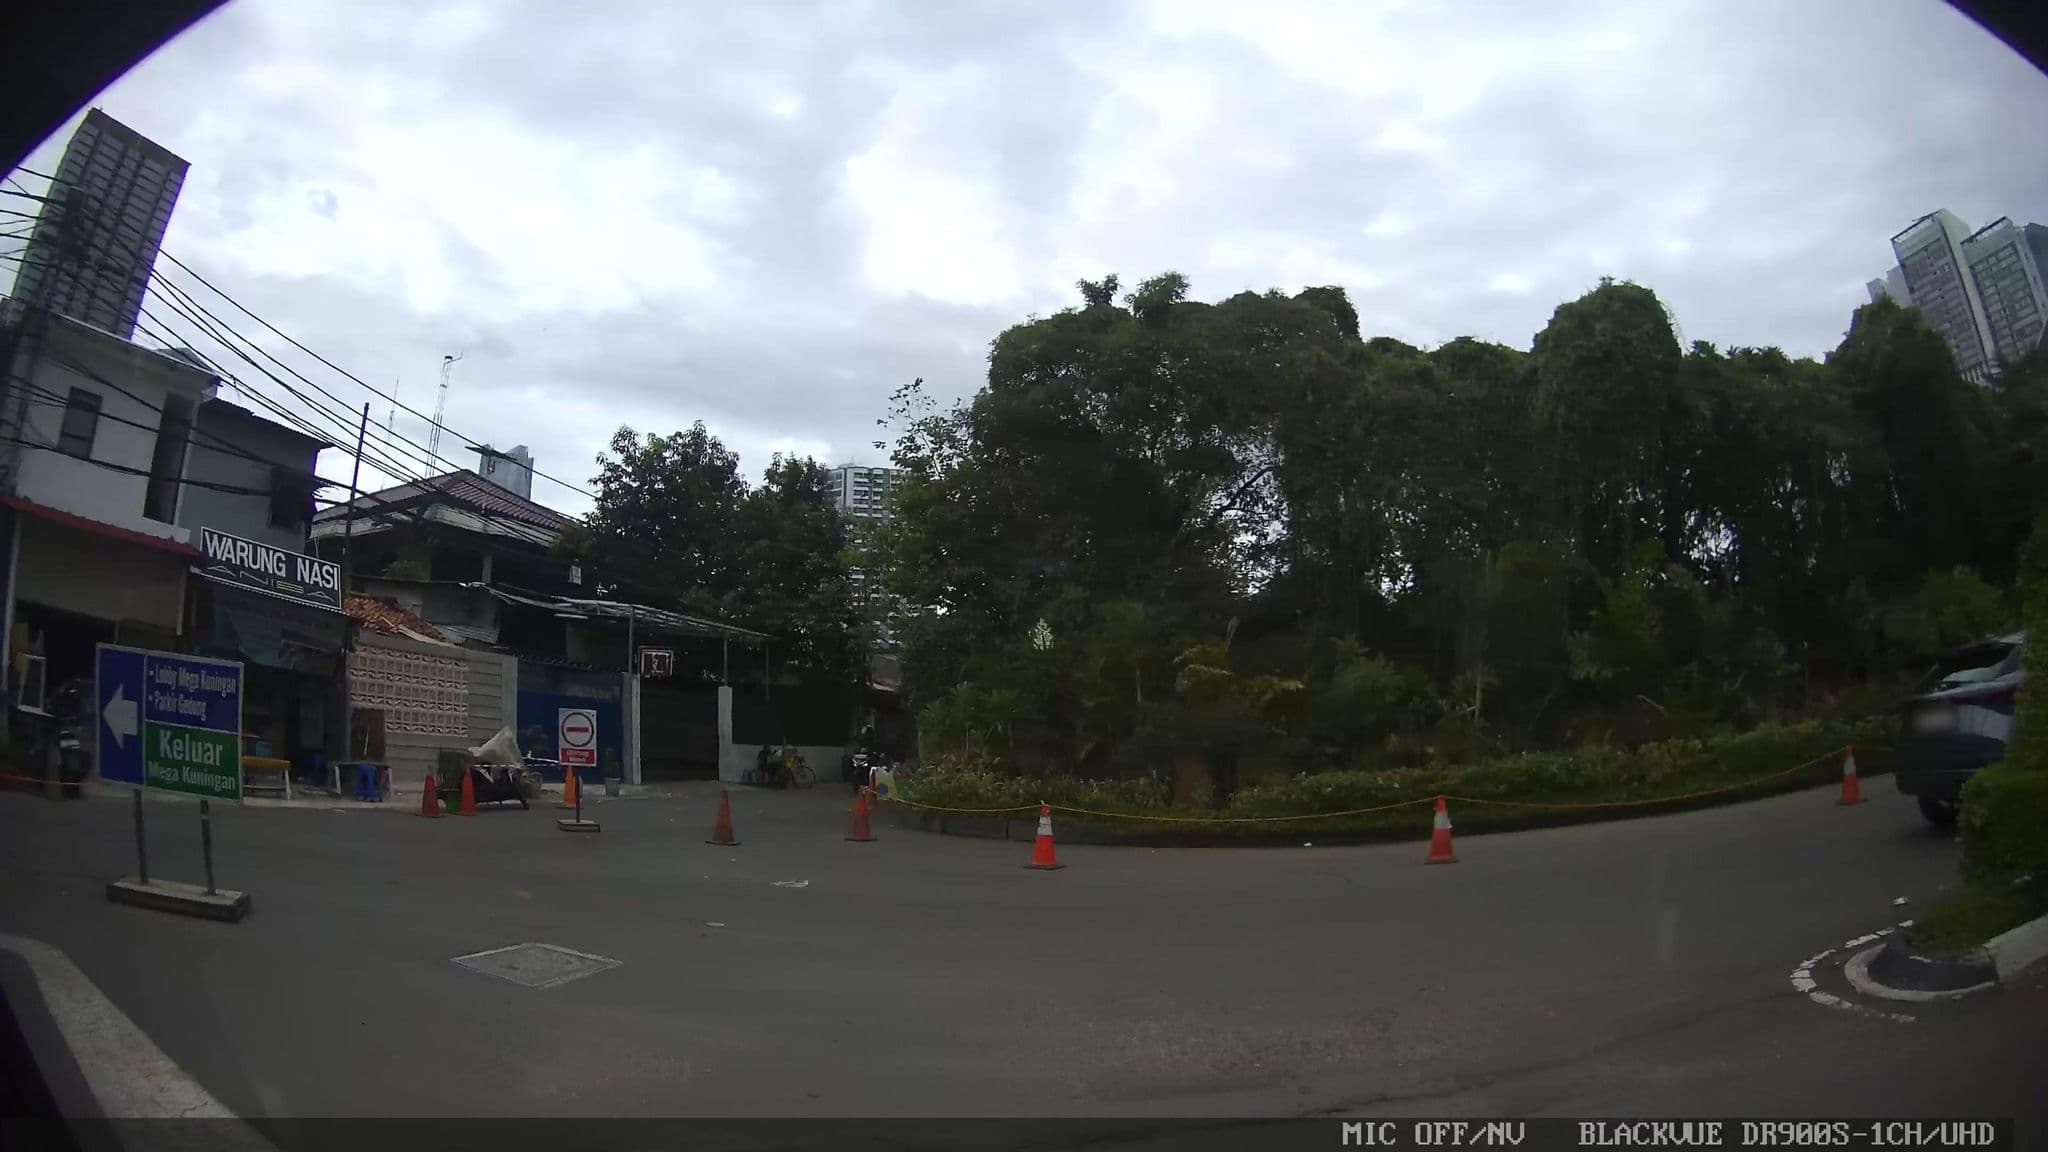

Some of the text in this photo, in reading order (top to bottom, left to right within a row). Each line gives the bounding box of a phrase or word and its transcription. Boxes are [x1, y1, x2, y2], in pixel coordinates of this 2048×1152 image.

[204, 531, 339, 591] WARUNG NASI
[155, 664, 237, 698] Lobby Mega Kuningan
[154, 690, 207, 721] Parkir Gedung
[159, 729, 223, 767] Keluar
[148, 760, 236, 792] Mega Kuningan
